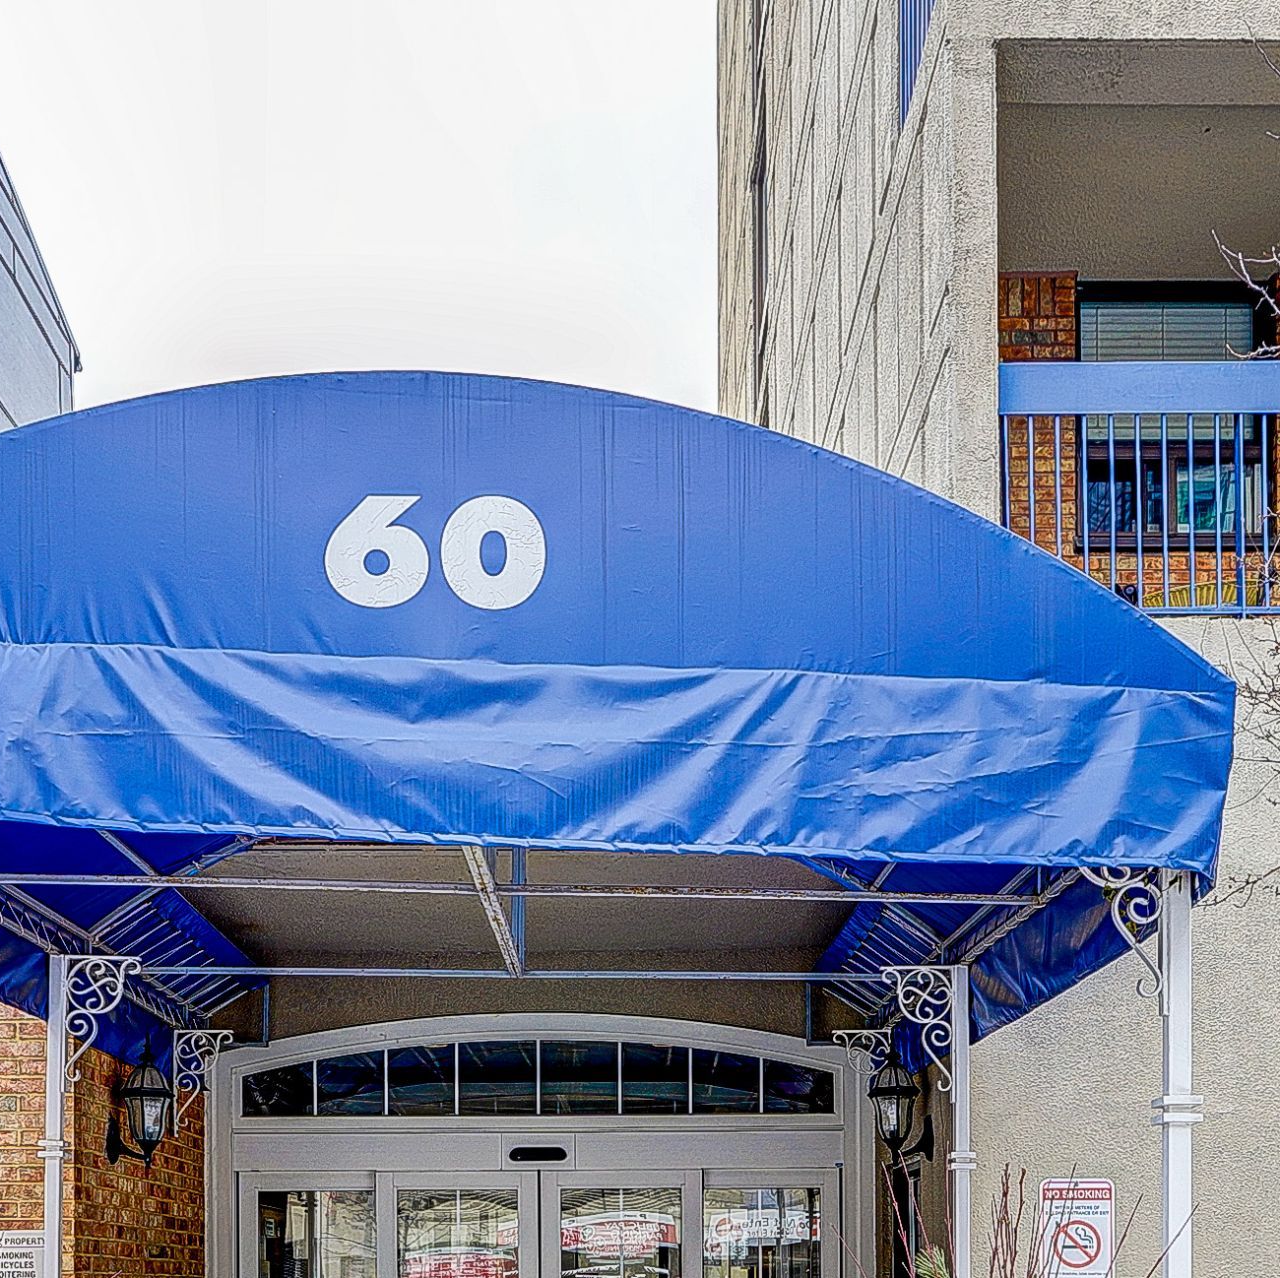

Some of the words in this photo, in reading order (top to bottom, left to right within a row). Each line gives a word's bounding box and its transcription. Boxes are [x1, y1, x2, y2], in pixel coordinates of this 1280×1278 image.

[323, 493, 547, 611] 60
[1044, 1190, 1060, 1199] NO
[1062, 1190, 1111, 1199] SMOKING
[4, 1237, 45, 1246] PROPERTY
